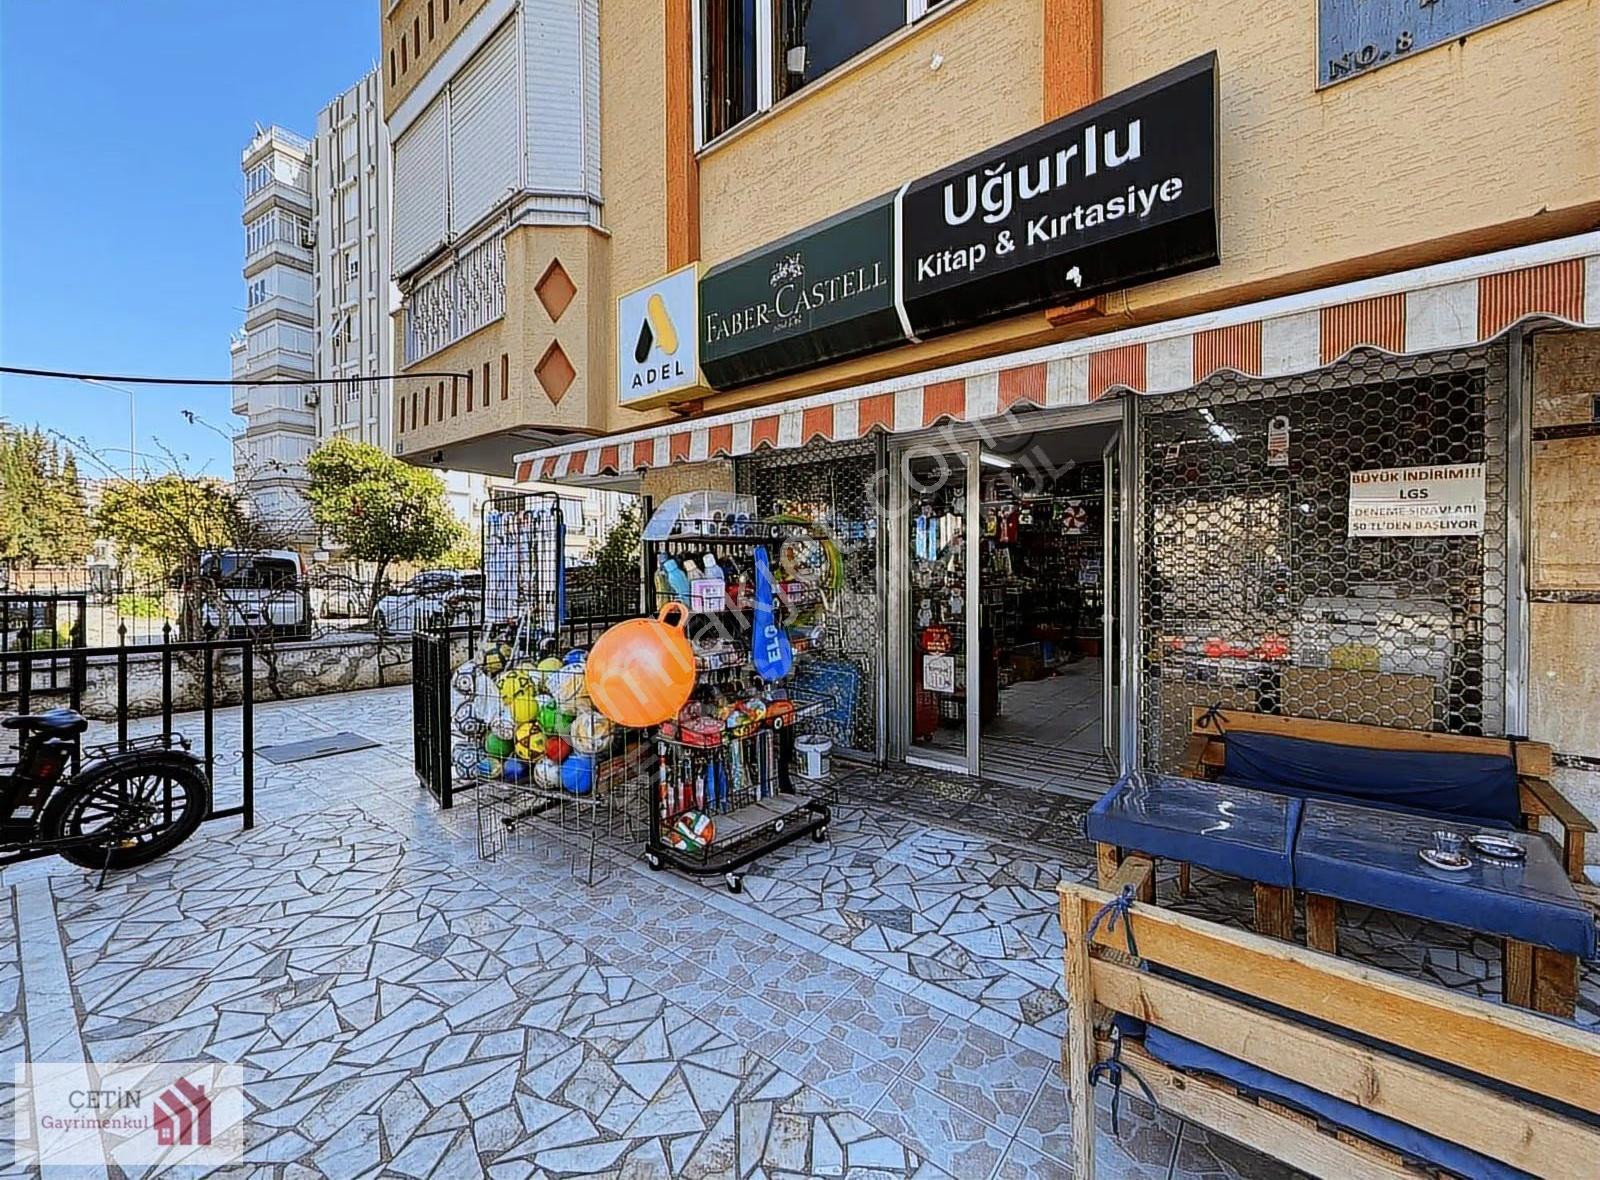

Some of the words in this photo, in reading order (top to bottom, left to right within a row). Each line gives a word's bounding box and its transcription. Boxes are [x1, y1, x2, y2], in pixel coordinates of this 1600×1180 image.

[944, 119, 1141, 226] Uğurlu
[917, 243, 986, 282] Kitap
[995, 230, 1015, 255] &
[1027, 177, 1183, 246] Kırtasiye
[706, 261, 887, 343] FABER-CASTELL
[631, 360, 684, 390] ADEL
[1352, 472, 1399, 484] BÜYÜK
[1403, 468, 1481, 481] İNDİRİM!!!
[1400, 489, 1429, 499] LGS
[1416, 520, 1477, 531] BAŞLIYOR
